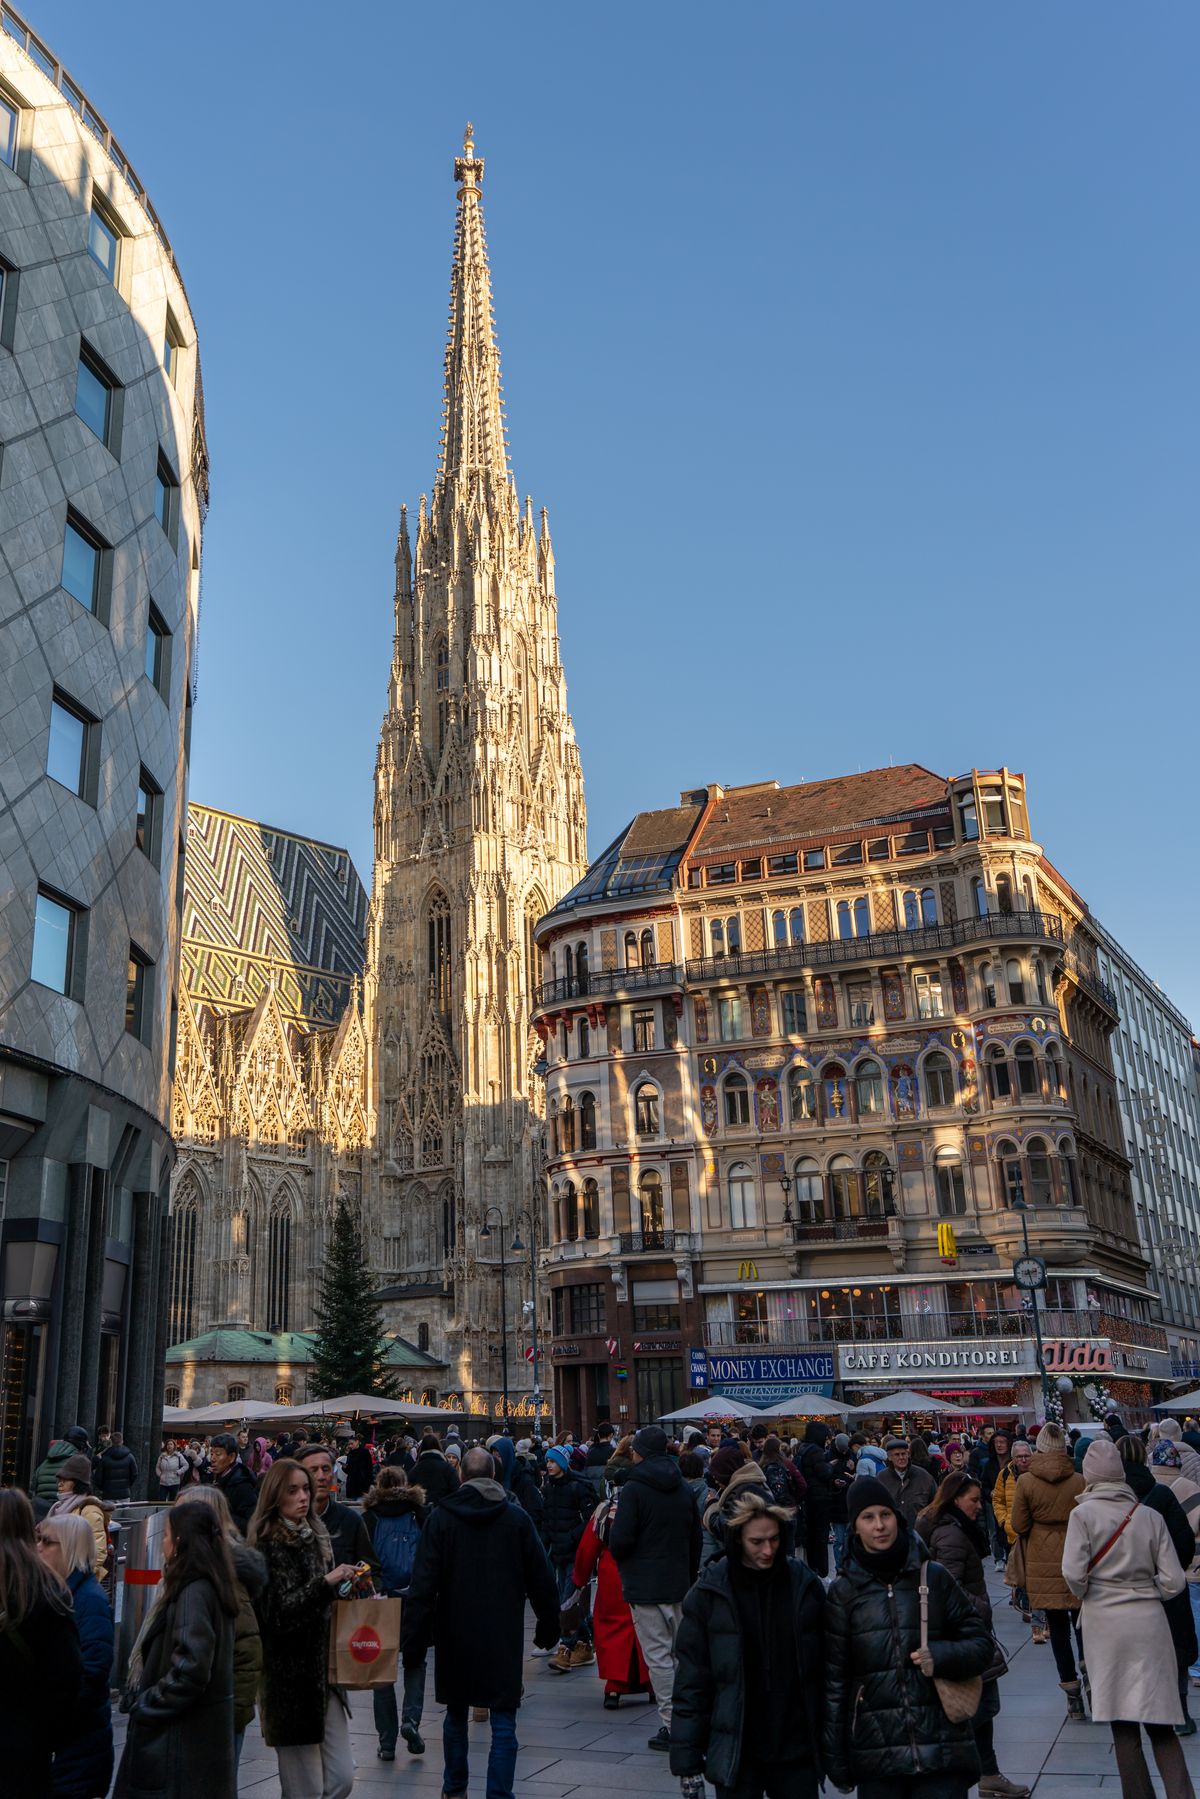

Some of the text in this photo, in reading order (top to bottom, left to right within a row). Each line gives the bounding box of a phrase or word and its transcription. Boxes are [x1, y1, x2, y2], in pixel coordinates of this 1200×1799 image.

[1141, 1087, 1180, 1227] HOTEL
[690, 1363, 708, 1373] CHANGE
[710, 1357, 833, 1379] MONEY EXCHANGE
[844, 1350, 1019, 1369] CAFE KONDITOREI
[721, 1384, 823, 1396] THE CHANGE GROUP
